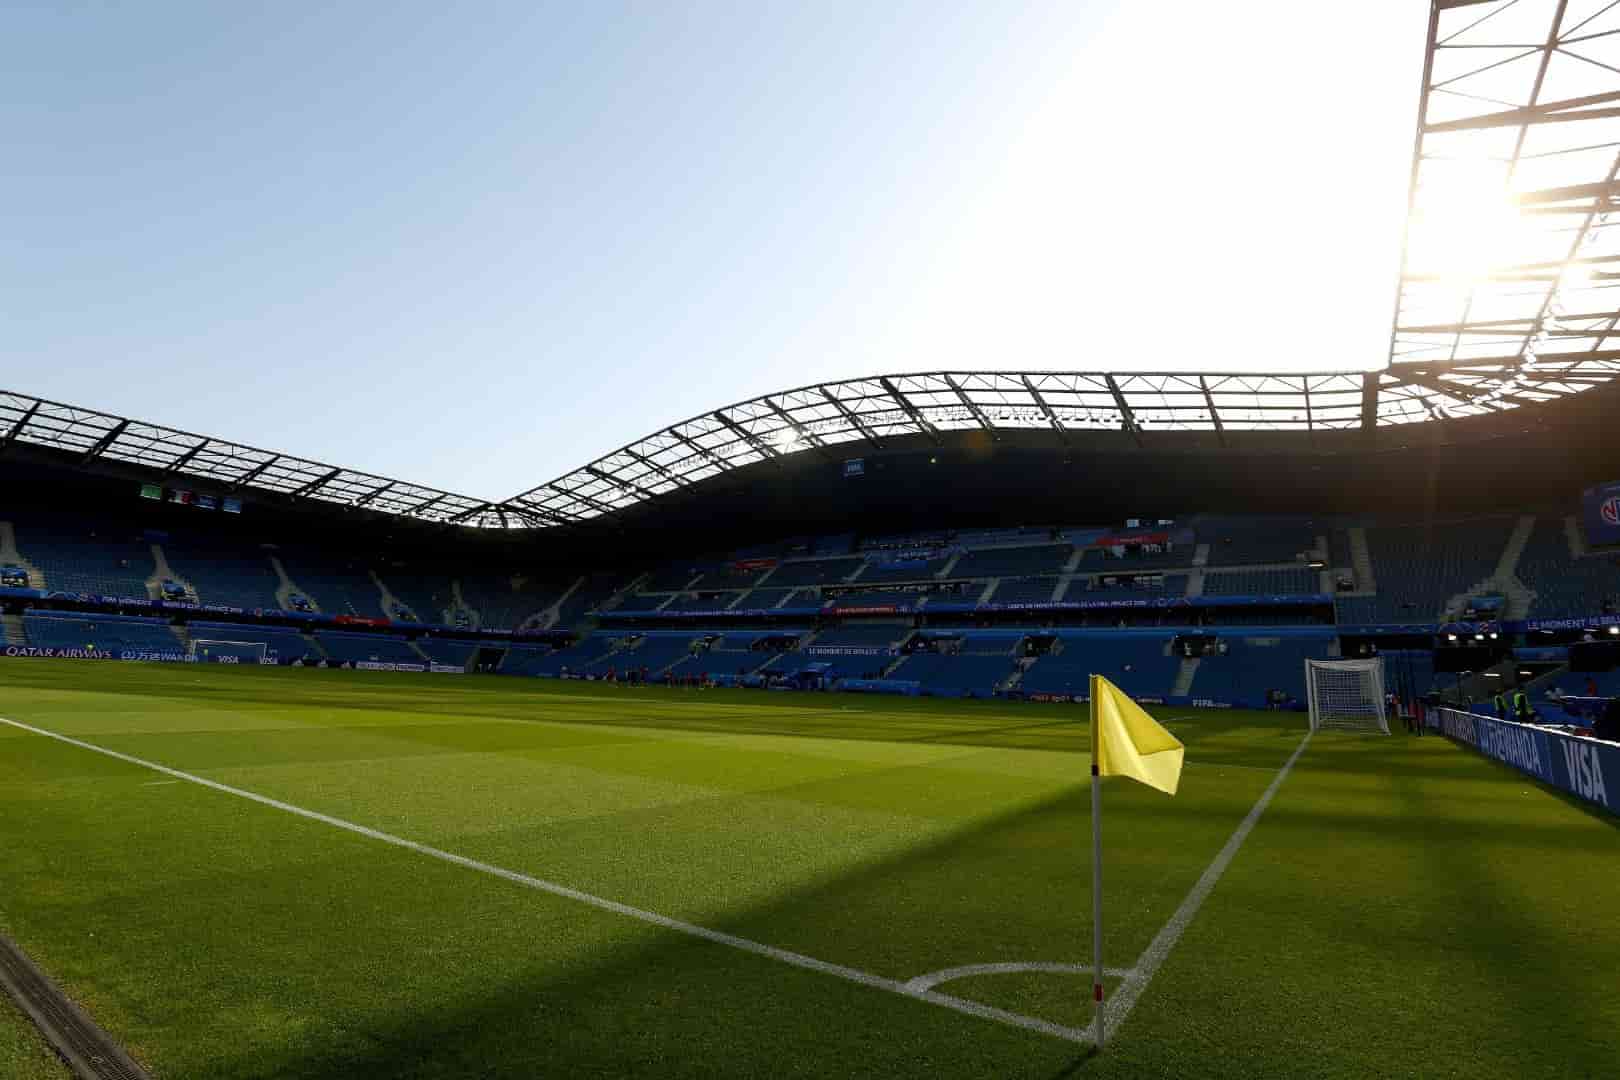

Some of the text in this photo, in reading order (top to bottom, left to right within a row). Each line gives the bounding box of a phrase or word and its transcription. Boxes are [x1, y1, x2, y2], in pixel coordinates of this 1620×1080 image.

[6, 646, 112, 659] QATAR AIRWAYS
[1560, 738, 1608, 806] VISA
